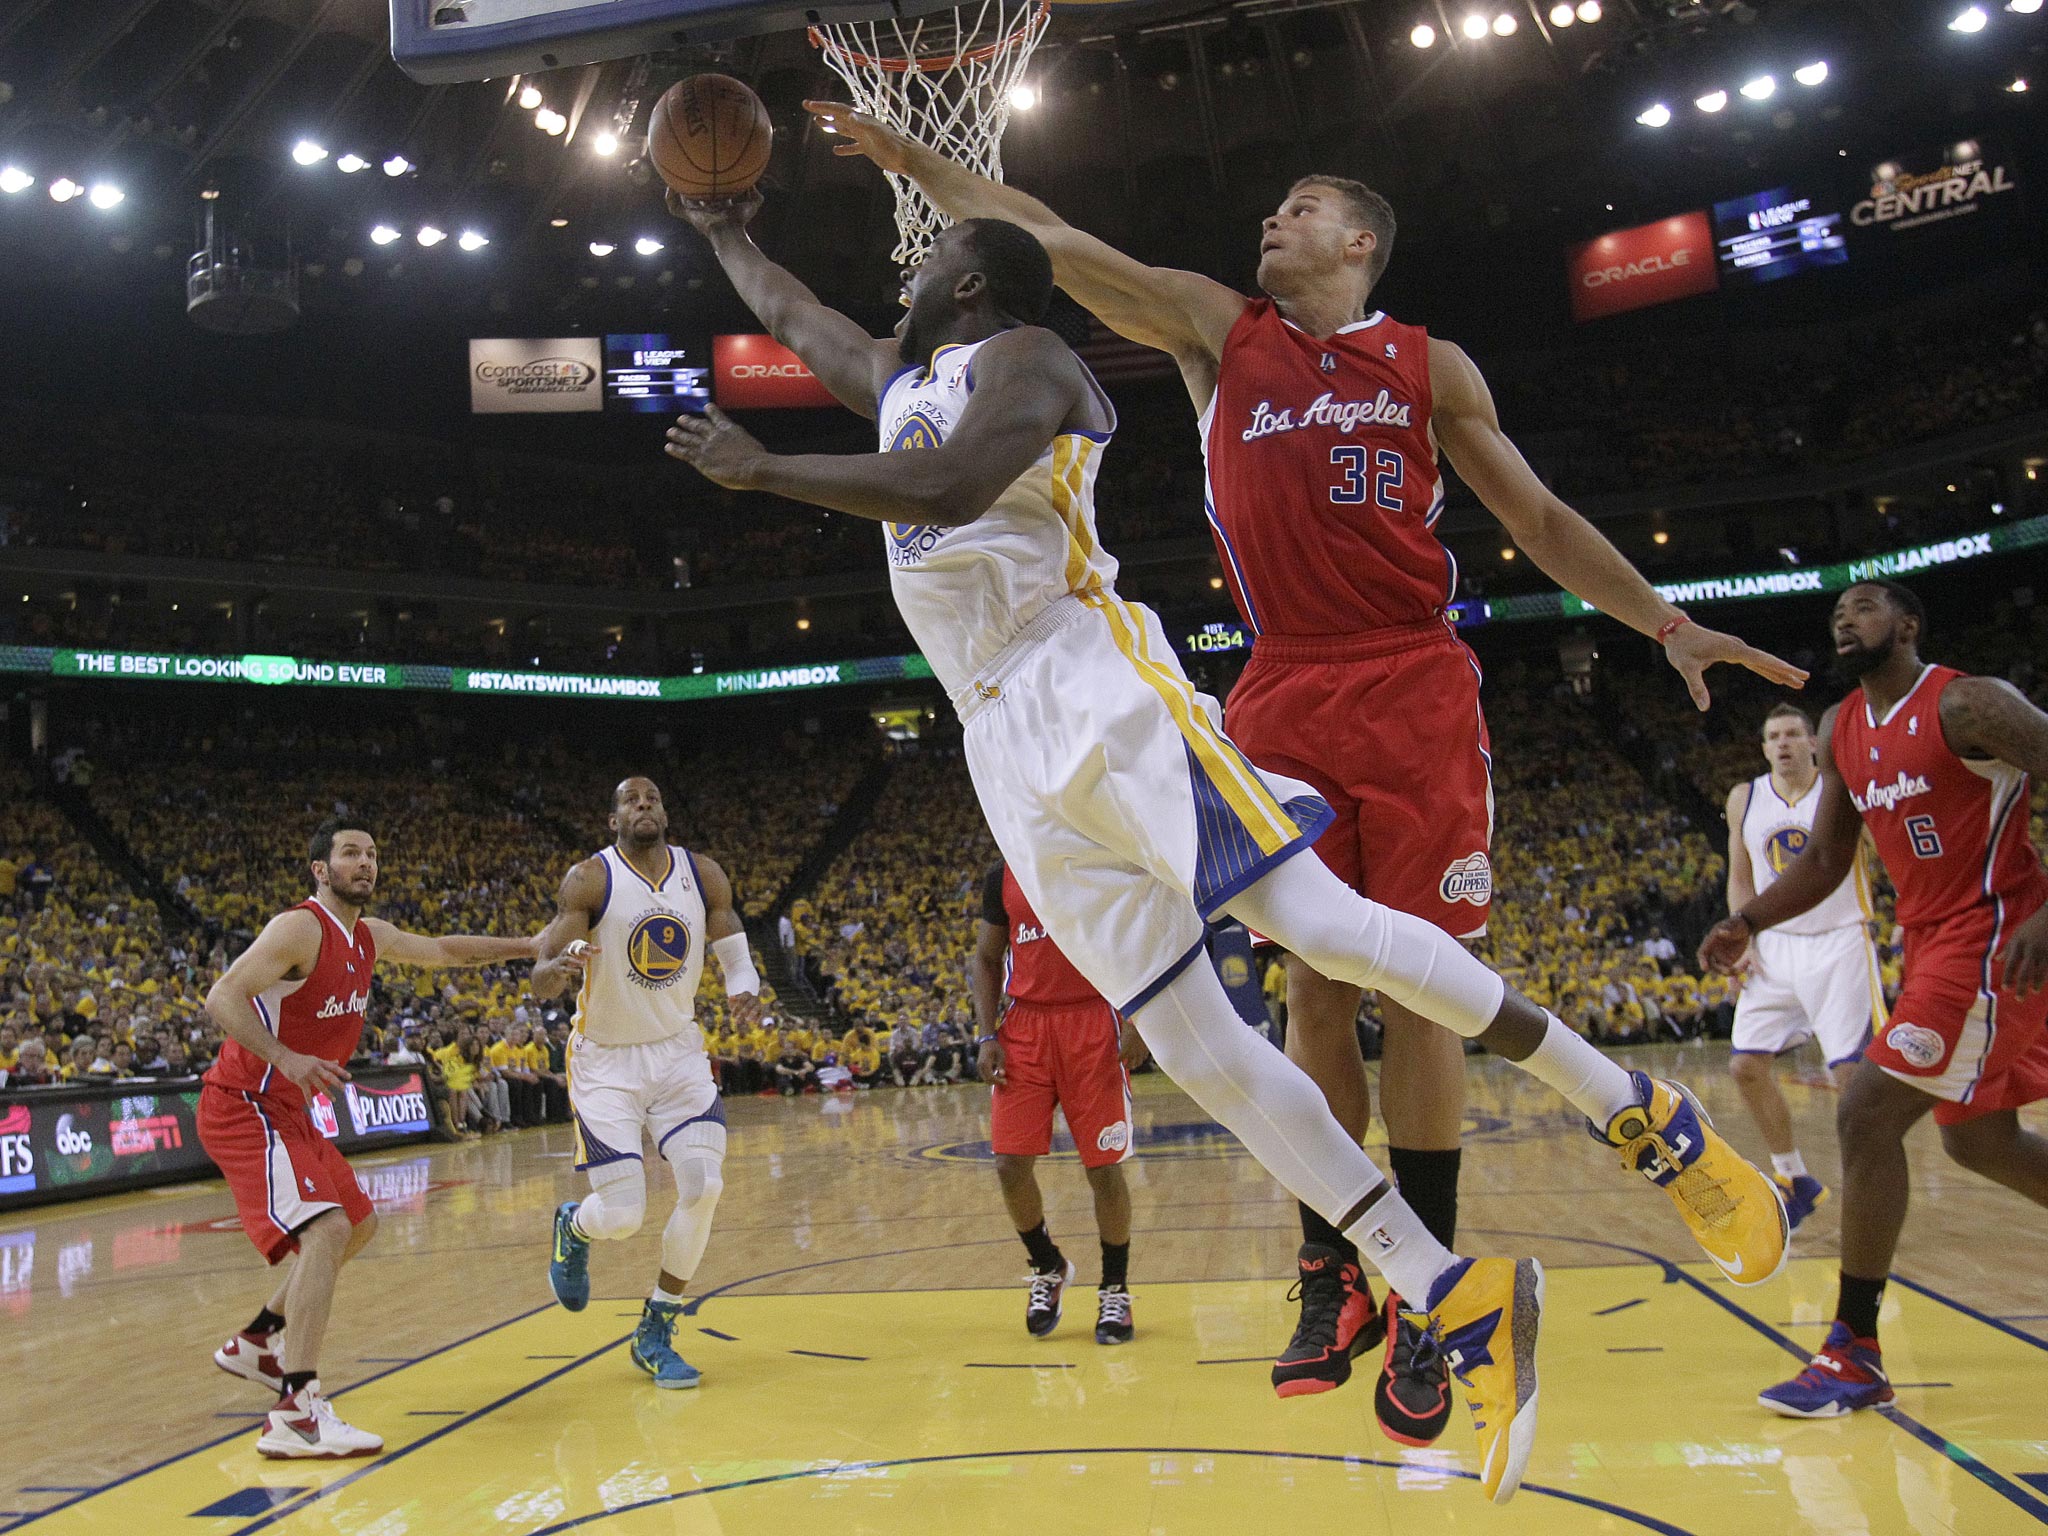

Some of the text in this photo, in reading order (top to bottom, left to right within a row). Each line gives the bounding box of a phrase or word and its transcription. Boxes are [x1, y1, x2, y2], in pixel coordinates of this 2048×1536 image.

[1851, 166, 2015, 226] CENTRAL
[1583, 249, 1692, 288] ORACLE
[497, 377, 581, 387] SPORTSNET
[915, 400, 949, 428] STATE
[1242, 389, 1411, 441] Los Angeles
[1330, 446, 1403, 512] 32
[1186, 630, 1244, 652] 10:54
[75, 653, 386, 684] THE BEST LOOKING SOUND EVER
[467, 672, 660, 697] #STARTSWITHJAMBOX
[1866, 771, 1932, 811] Angeles
[1788, 832, 1804, 848] 10
[1904, 814, 1944, 859] 6
[628, 907, 693, 929] GOLDEN STATE
[663, 926, 675, 944] 9
[1016, 923, 1039, 944] Los
[626, 966, 688, 992] WARRIORS
[316, 995, 345, 1019] Los
[359, 1093, 427, 1127] PLAYOFFS
[0, 1133, 33, 1176] FS
[56, 1126, 92, 1155] abc
